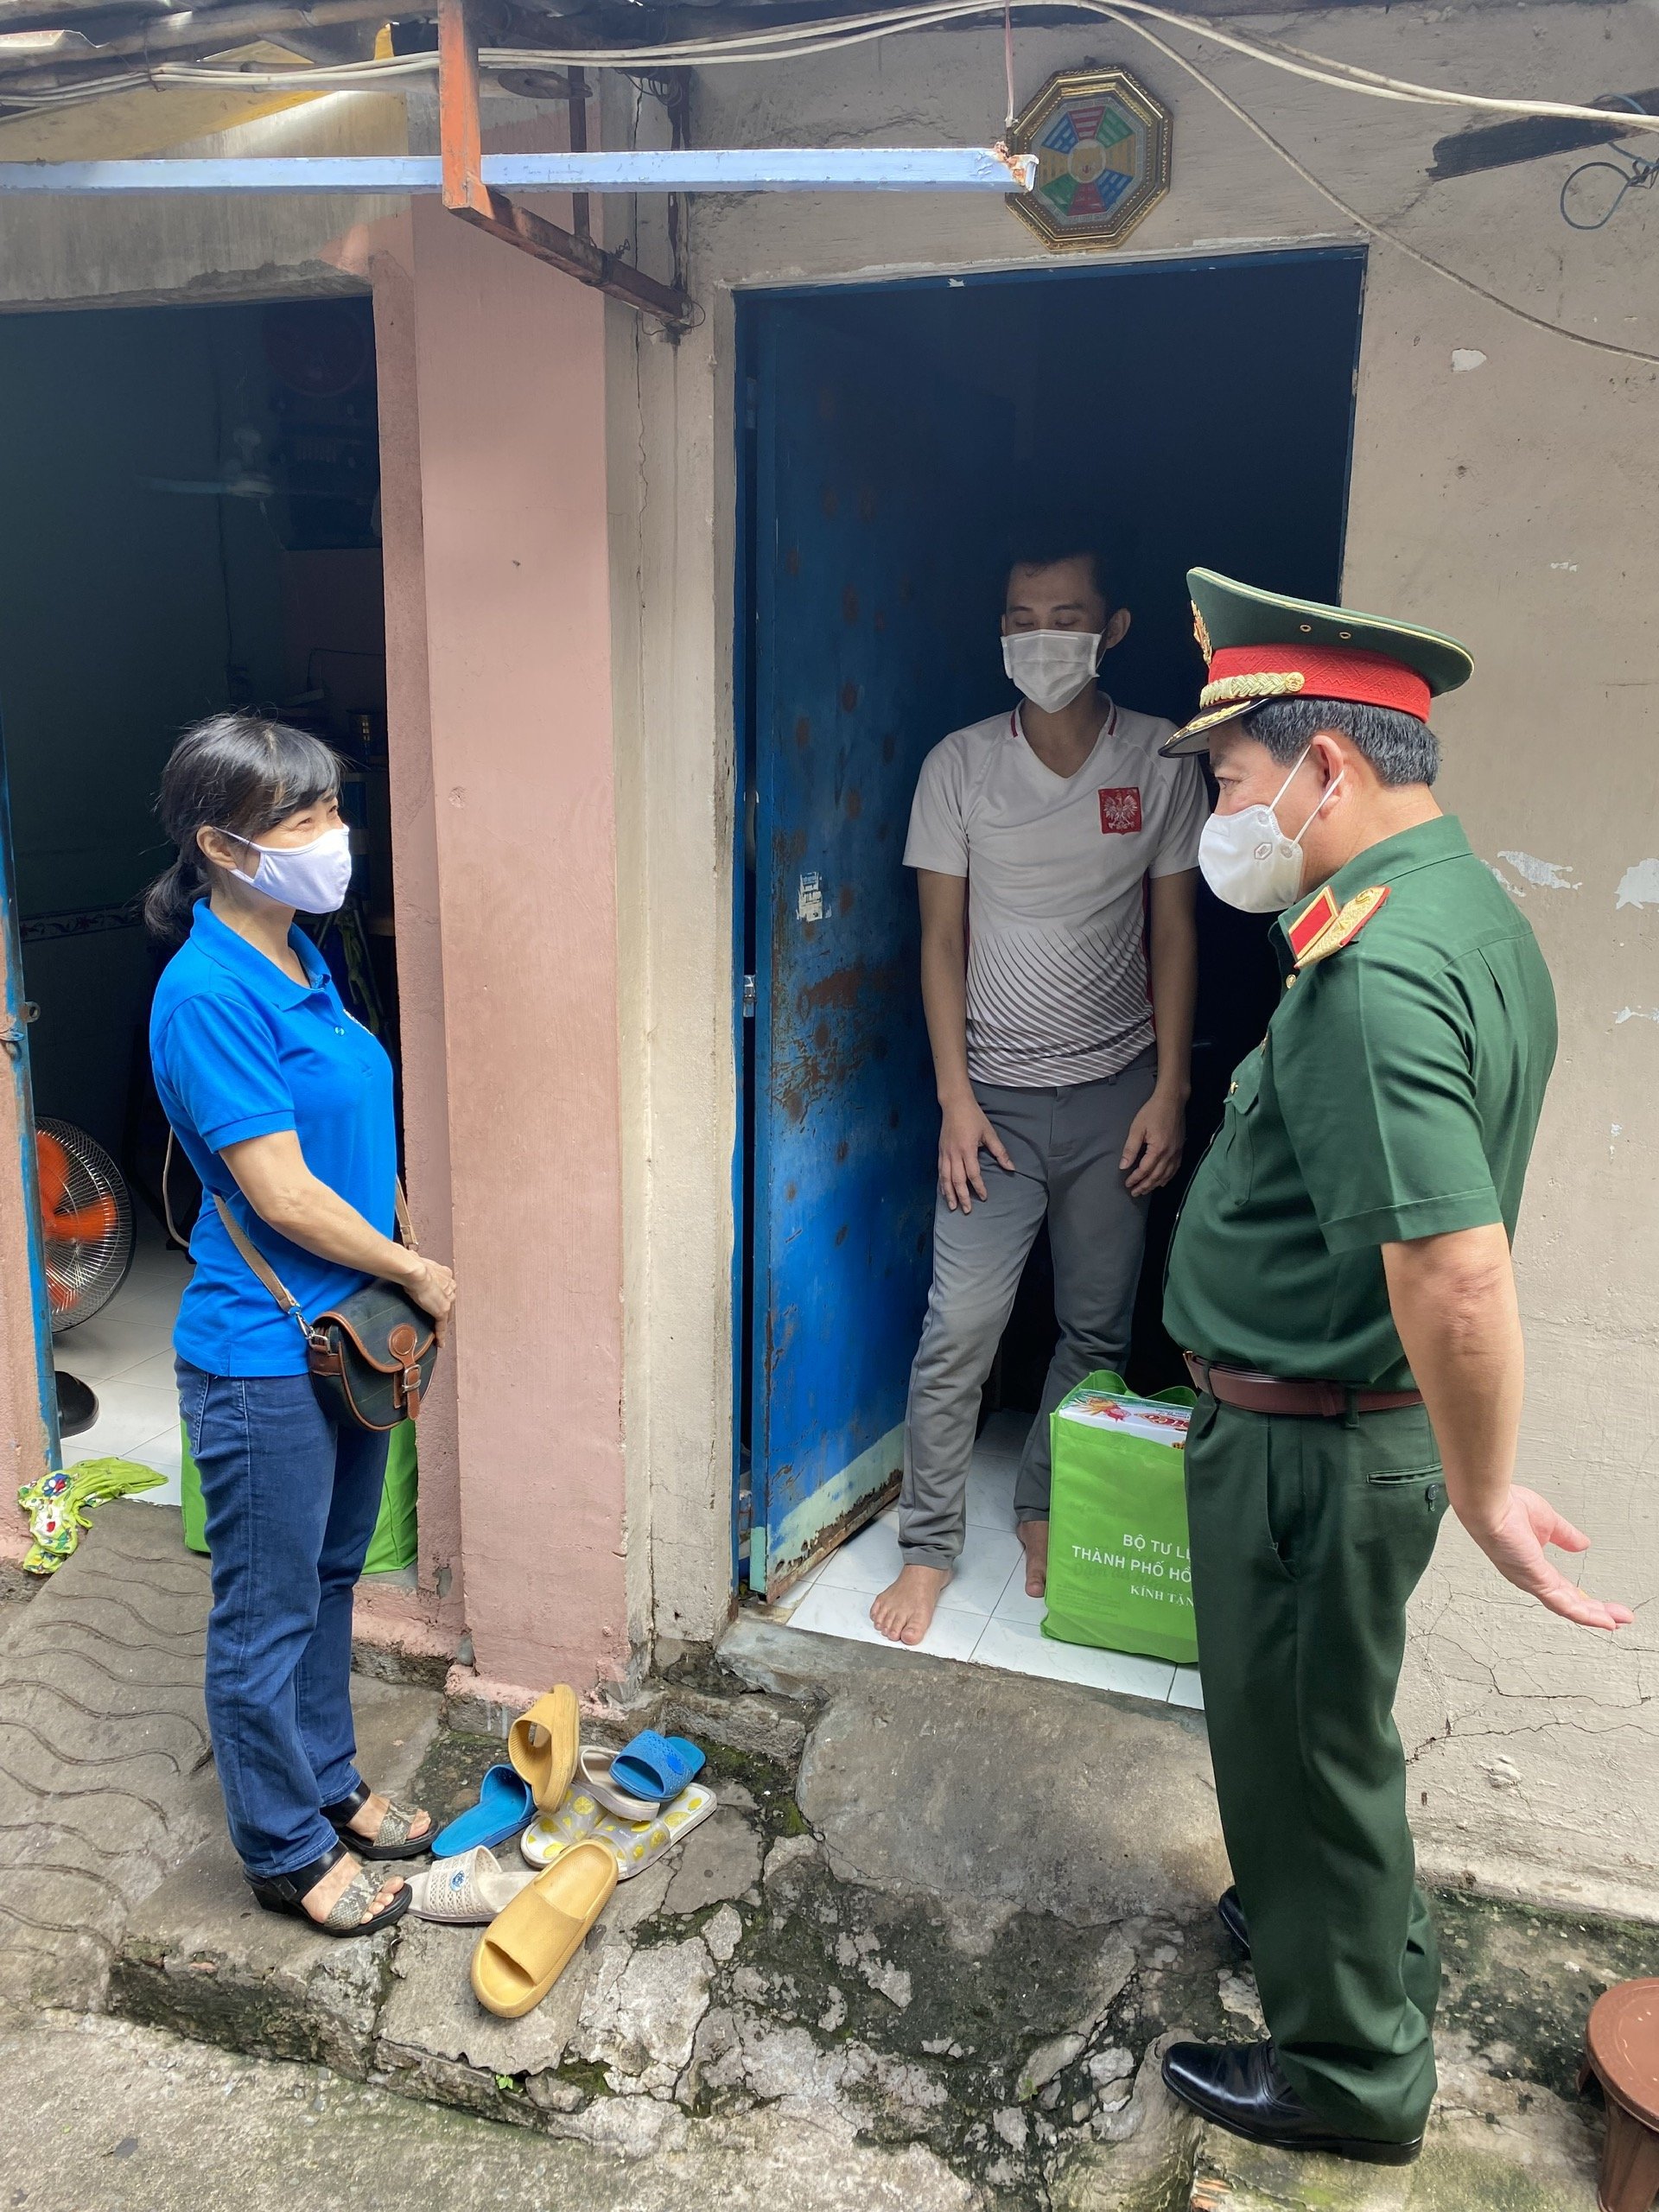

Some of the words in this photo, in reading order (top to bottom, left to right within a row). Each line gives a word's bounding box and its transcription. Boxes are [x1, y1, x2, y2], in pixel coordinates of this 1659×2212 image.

[1122, 1534, 1146, 1552] BỘ
[1150, 1540, 1173, 1555] TƯ
[1071, 1545, 1126, 1569] THÀNH
[1130, 1559, 1165, 1577] PHỐ
[1130, 1585, 1163, 1601] KÍNH
